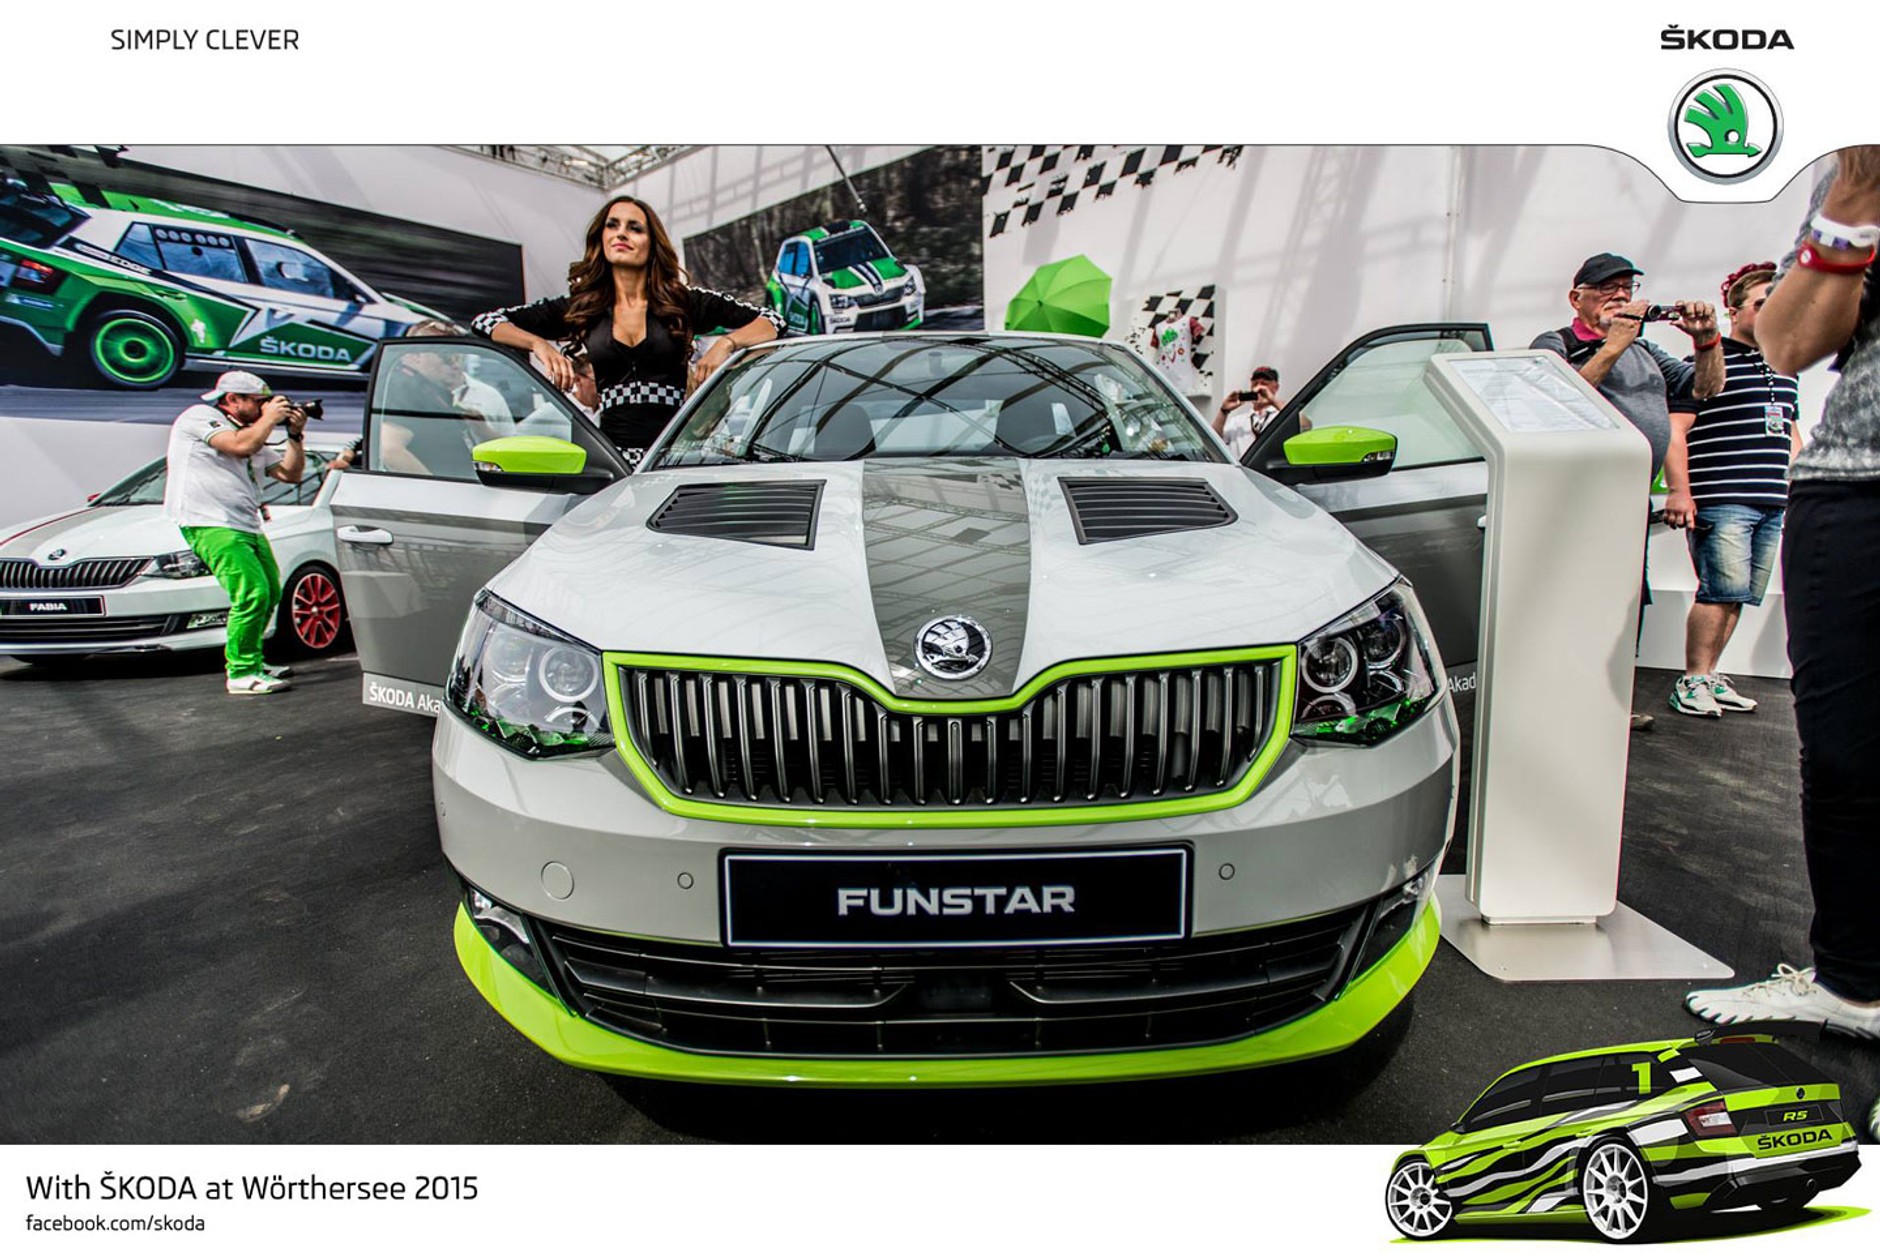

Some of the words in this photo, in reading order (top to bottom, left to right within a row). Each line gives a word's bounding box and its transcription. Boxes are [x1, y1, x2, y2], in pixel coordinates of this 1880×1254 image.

[260, 335, 353, 362] ŠKODA
[28, 602, 68, 612] FABIA
[368, 680, 416, 710] ŠKODA
[837, 885, 1076, 916] FUNSTAR
